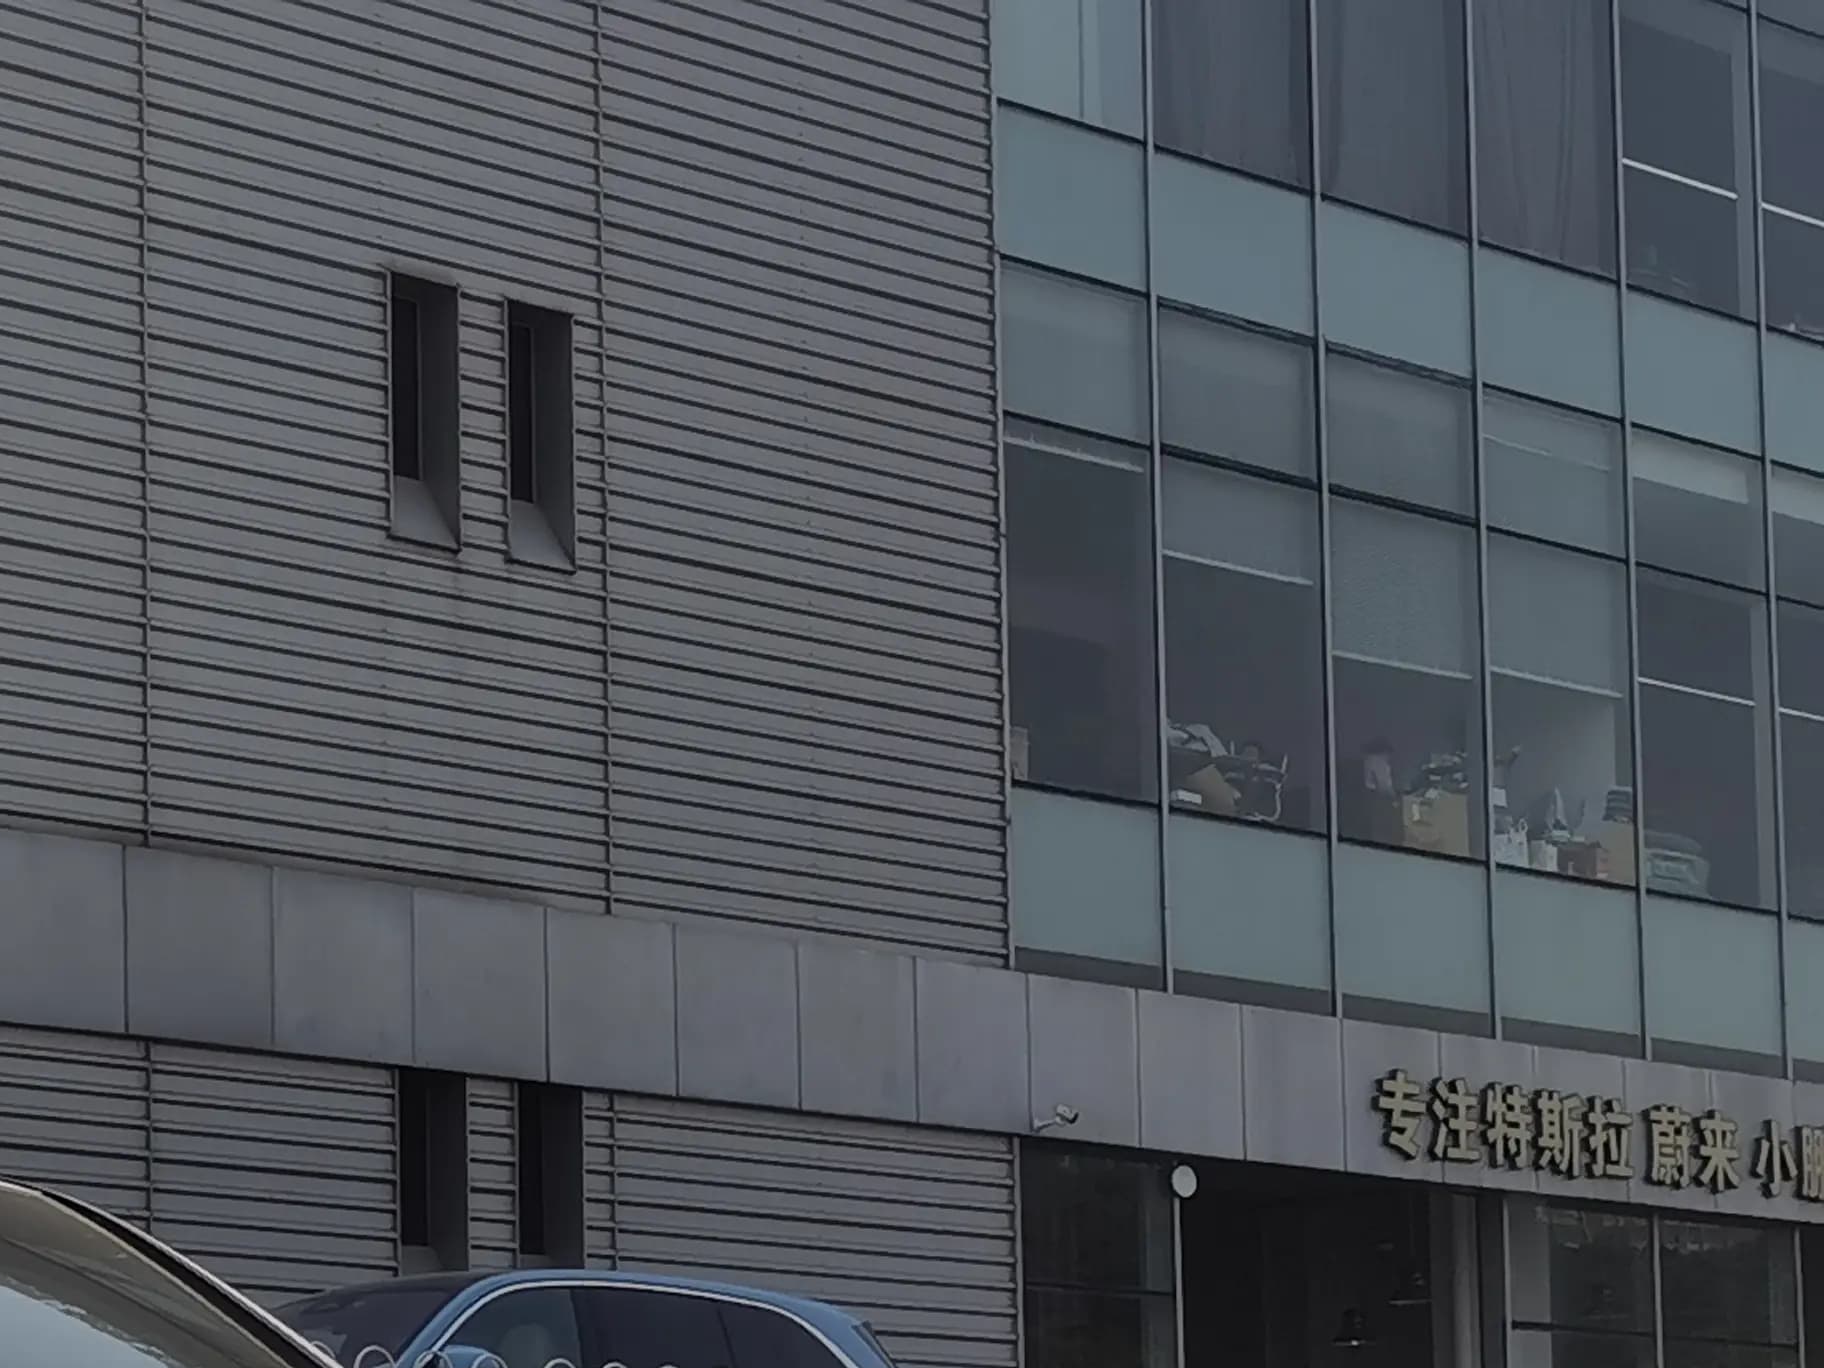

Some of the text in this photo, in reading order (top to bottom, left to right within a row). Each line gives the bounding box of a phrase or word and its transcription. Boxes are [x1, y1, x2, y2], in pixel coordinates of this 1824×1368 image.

[1375, 1069, 1634, 1179] 专注特斯拉
[1646, 1104, 1740, 1192] 蔚来
